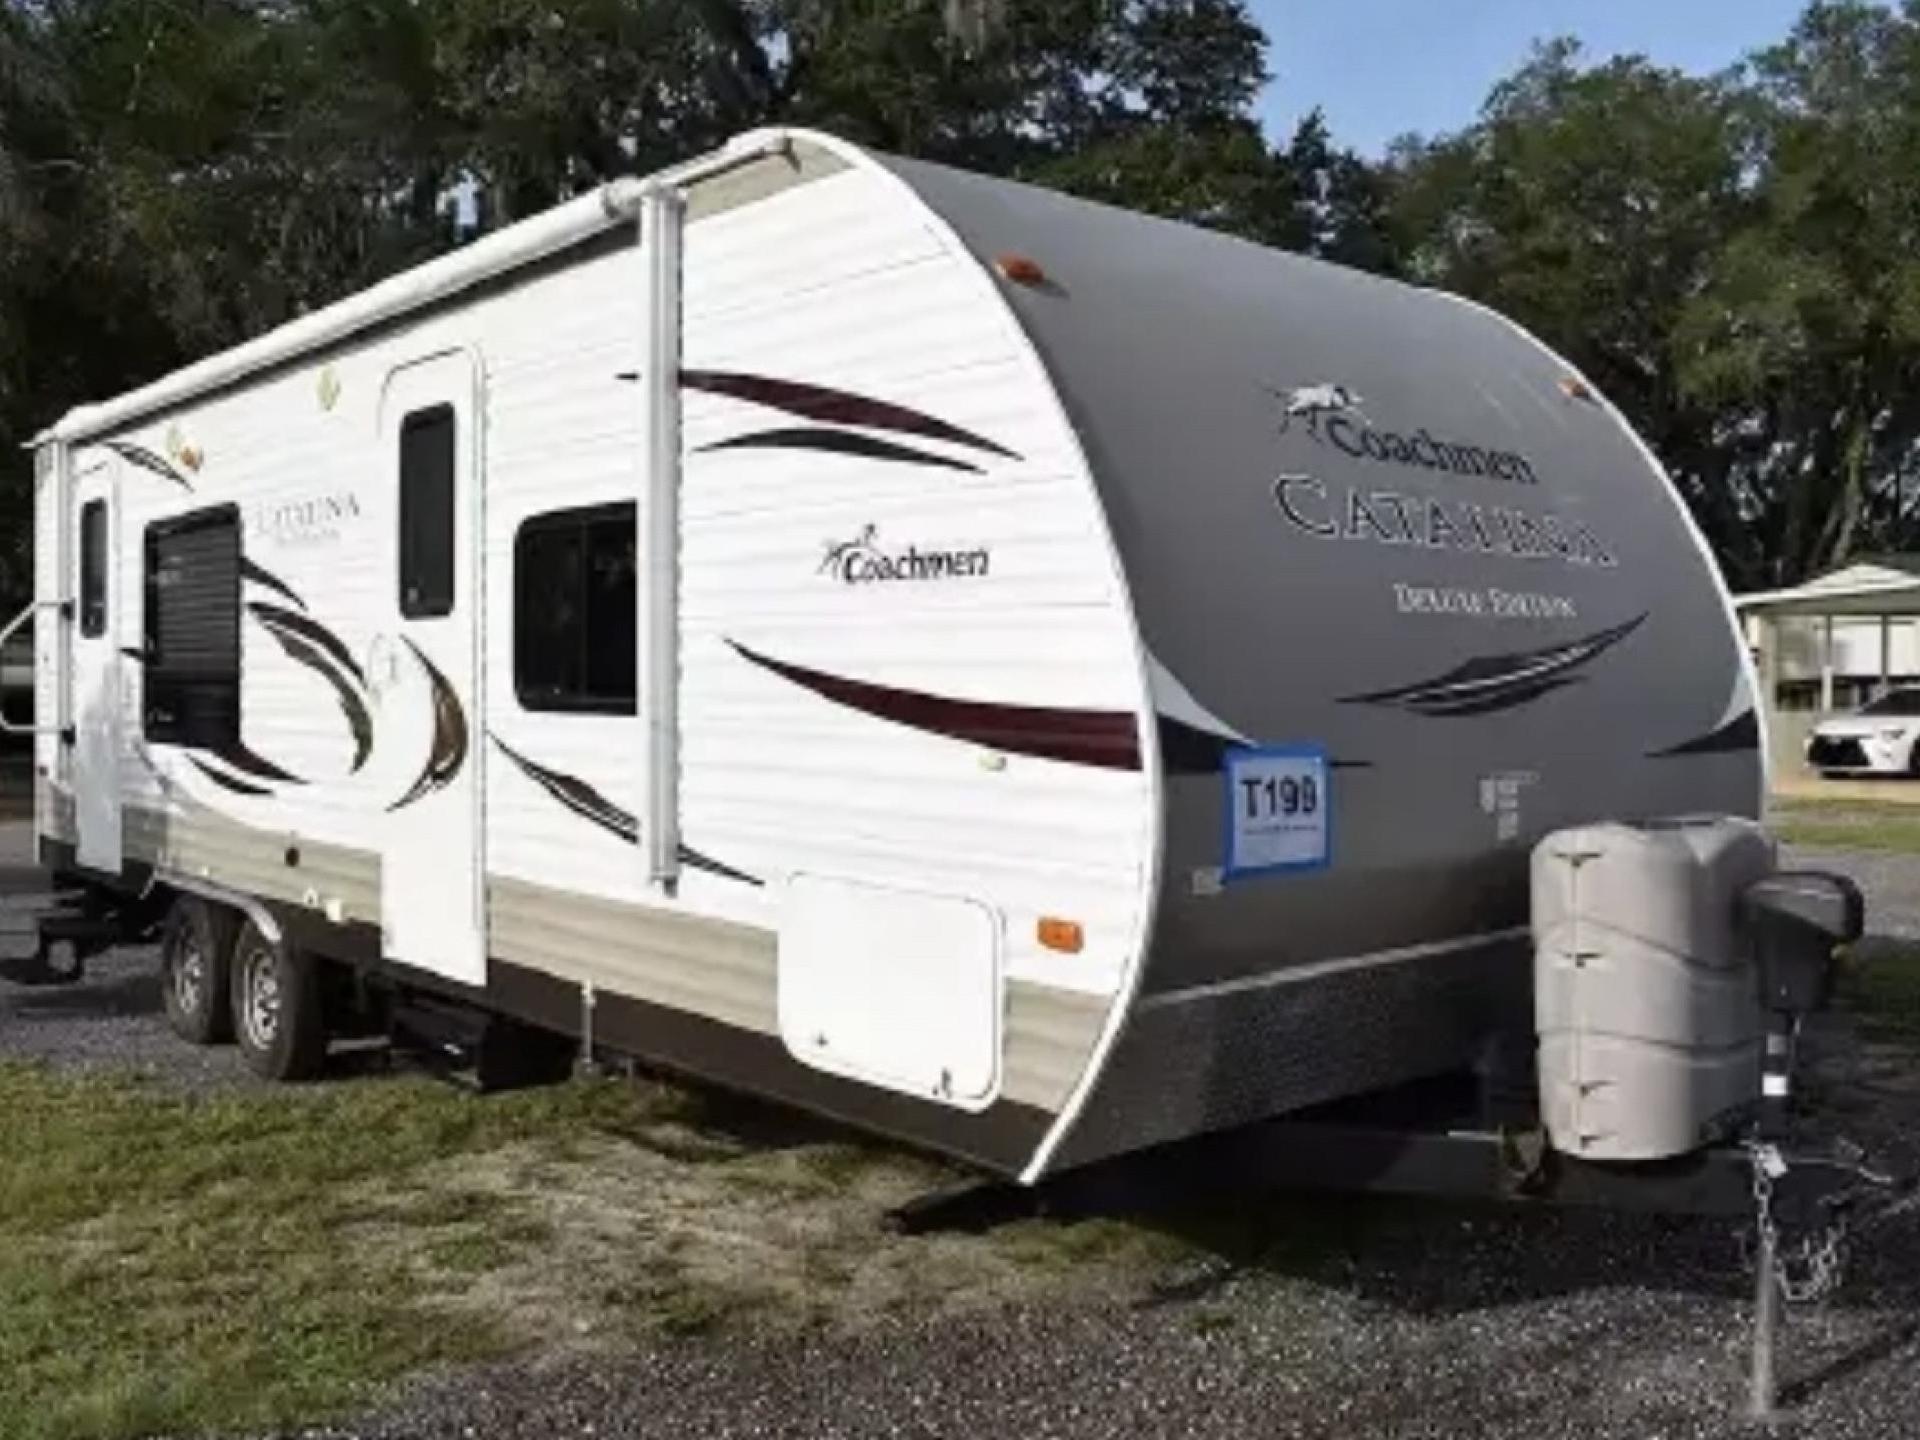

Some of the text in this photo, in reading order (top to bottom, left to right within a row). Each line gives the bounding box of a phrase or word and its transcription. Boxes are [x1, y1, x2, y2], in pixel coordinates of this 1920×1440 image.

[1326, 416, 1538, 484] Coachmen
[1273, 474, 1617, 566] CATALINA
[844, 546, 988, 583] Coachmen
